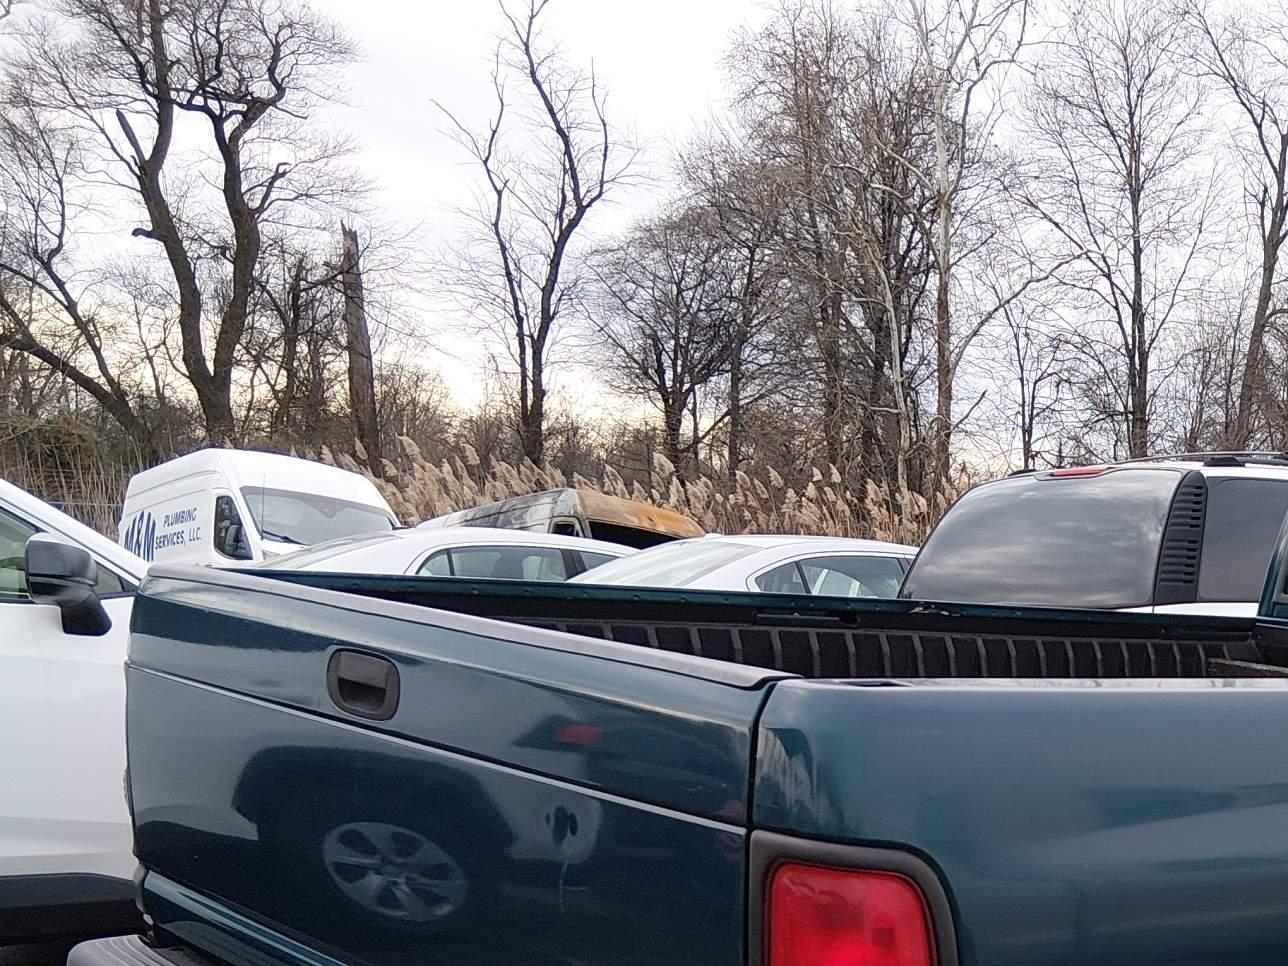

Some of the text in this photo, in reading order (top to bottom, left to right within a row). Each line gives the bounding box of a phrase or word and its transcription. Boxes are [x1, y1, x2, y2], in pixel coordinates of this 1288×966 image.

[163, 507, 197, 528] PLUMBING
[123, 510, 156, 562] M&M
[155, 530, 186, 550] SERVICES,
